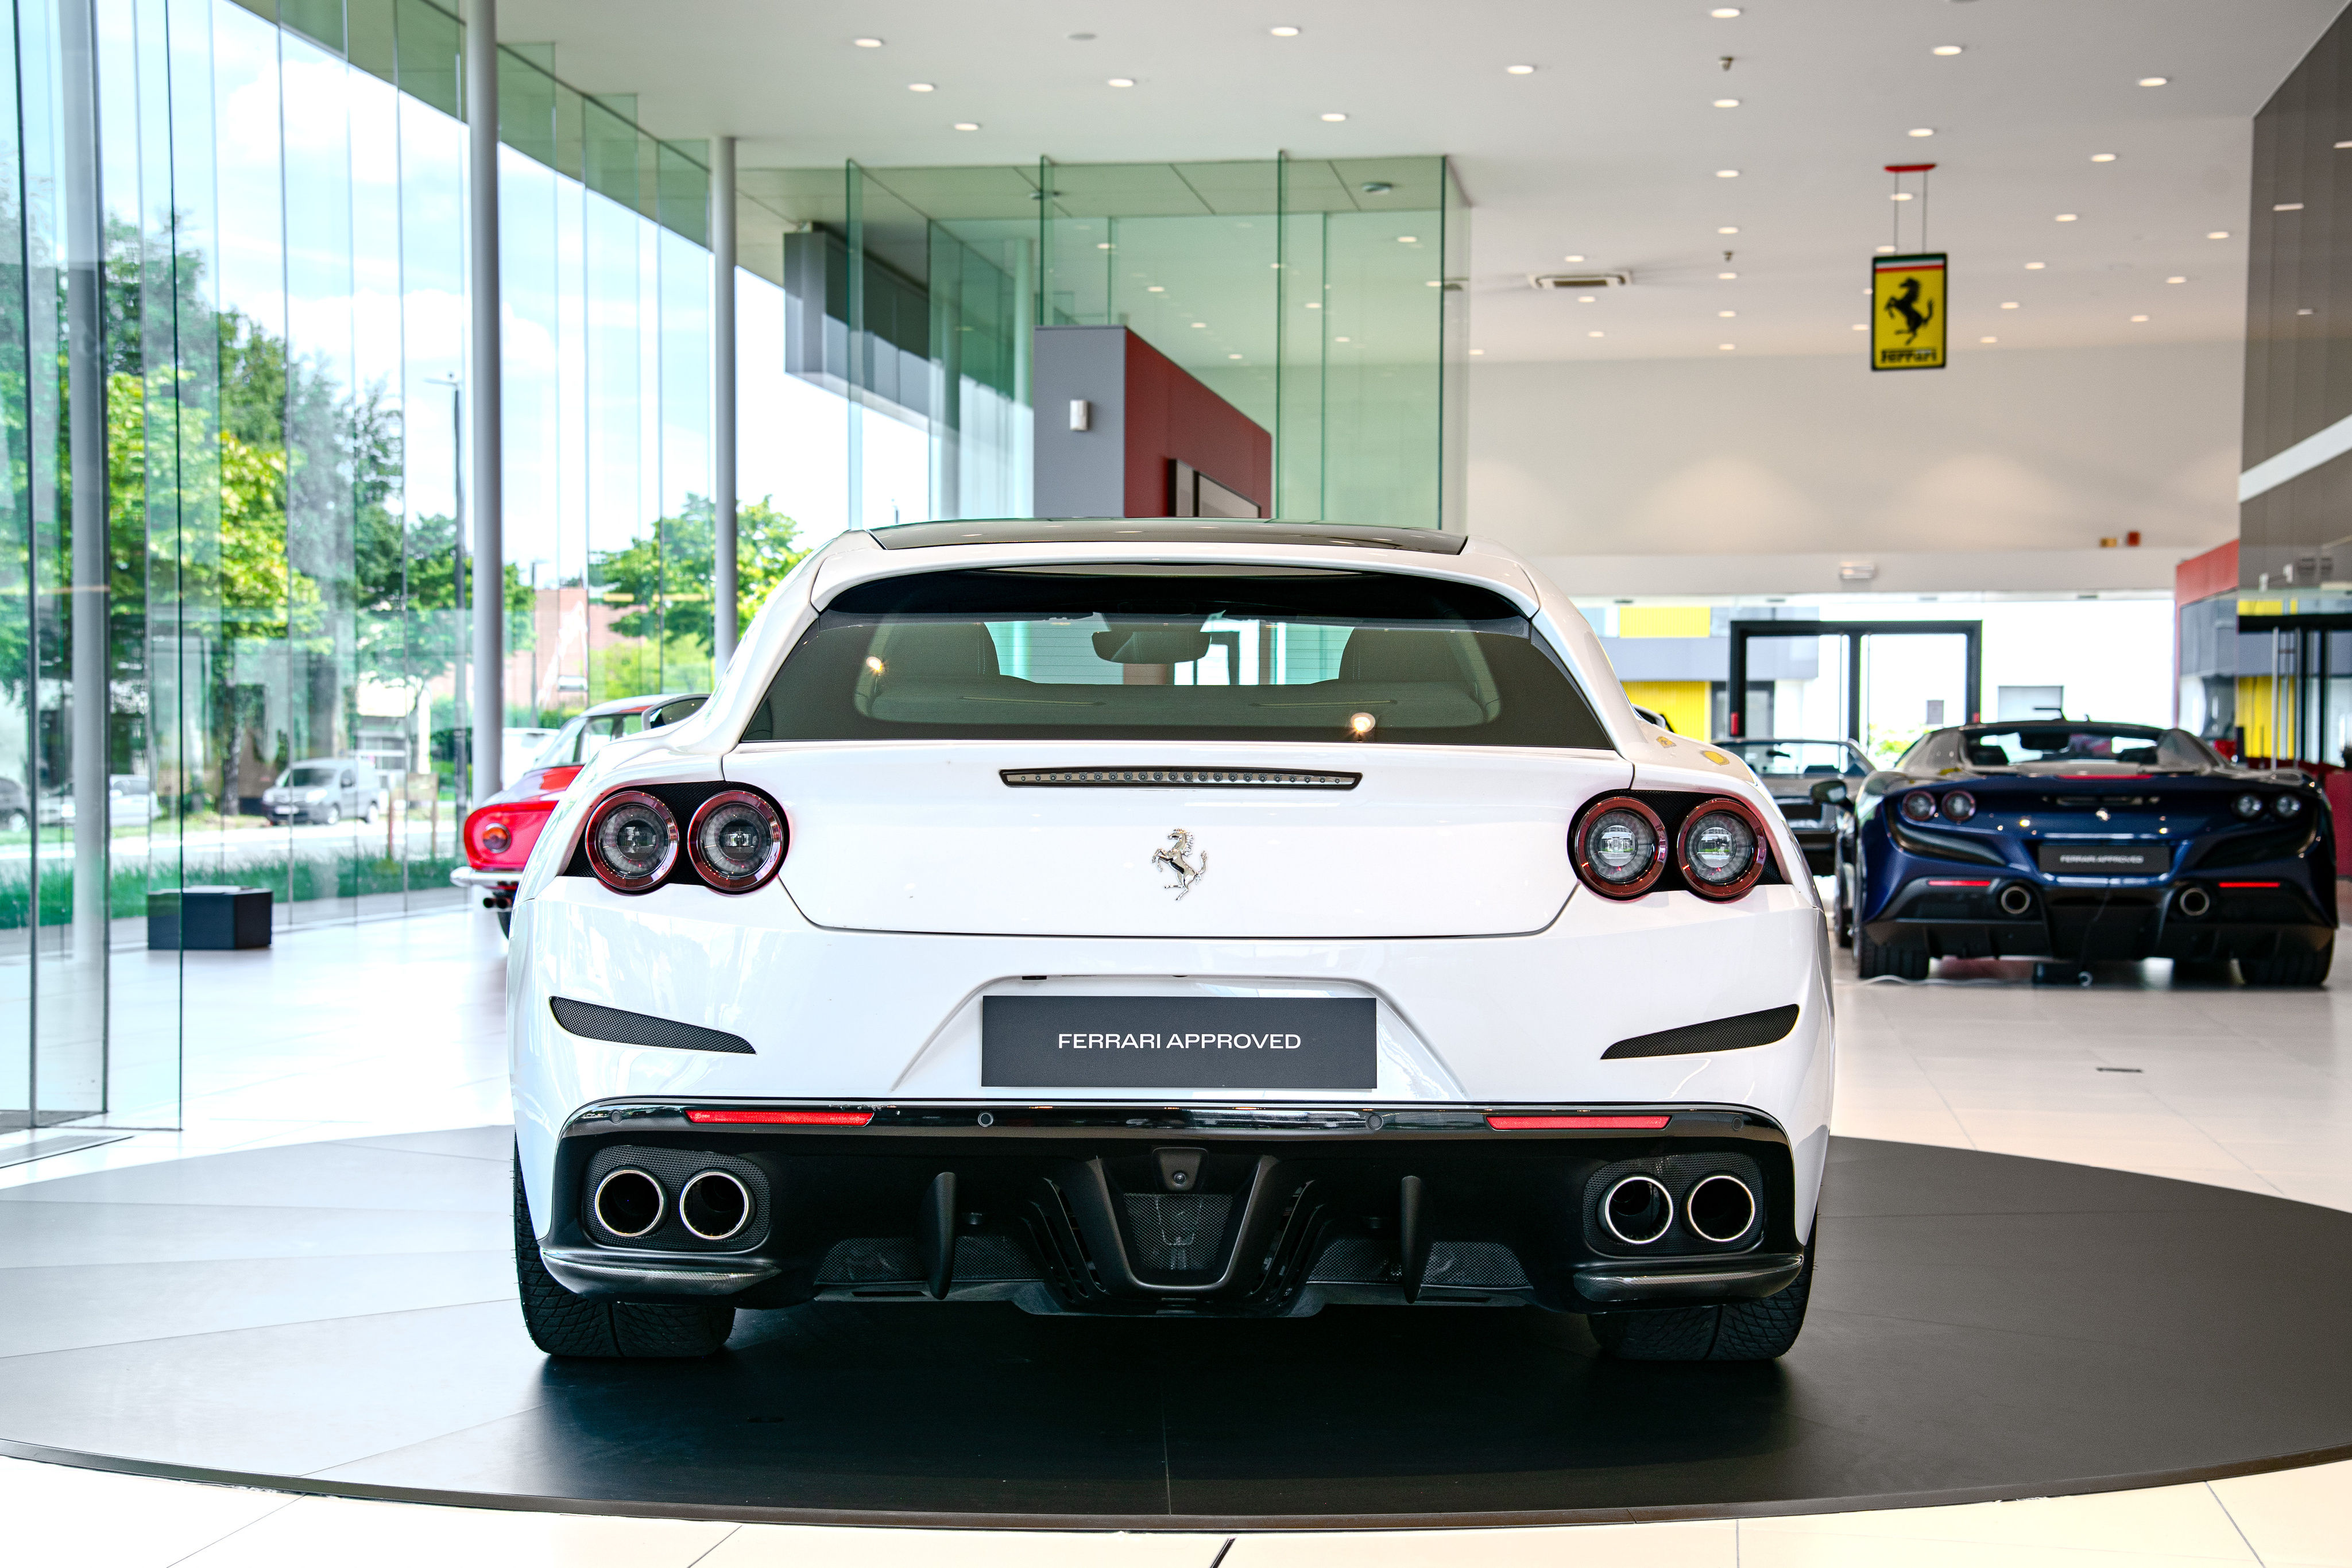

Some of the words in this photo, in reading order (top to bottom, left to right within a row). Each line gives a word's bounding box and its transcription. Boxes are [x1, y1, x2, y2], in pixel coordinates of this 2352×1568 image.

[1881, 349, 1936, 363] Ferrari
[1058, 1033, 1160, 1049] FERRARI
[1166, 1033, 1301, 1050] APPROVED
